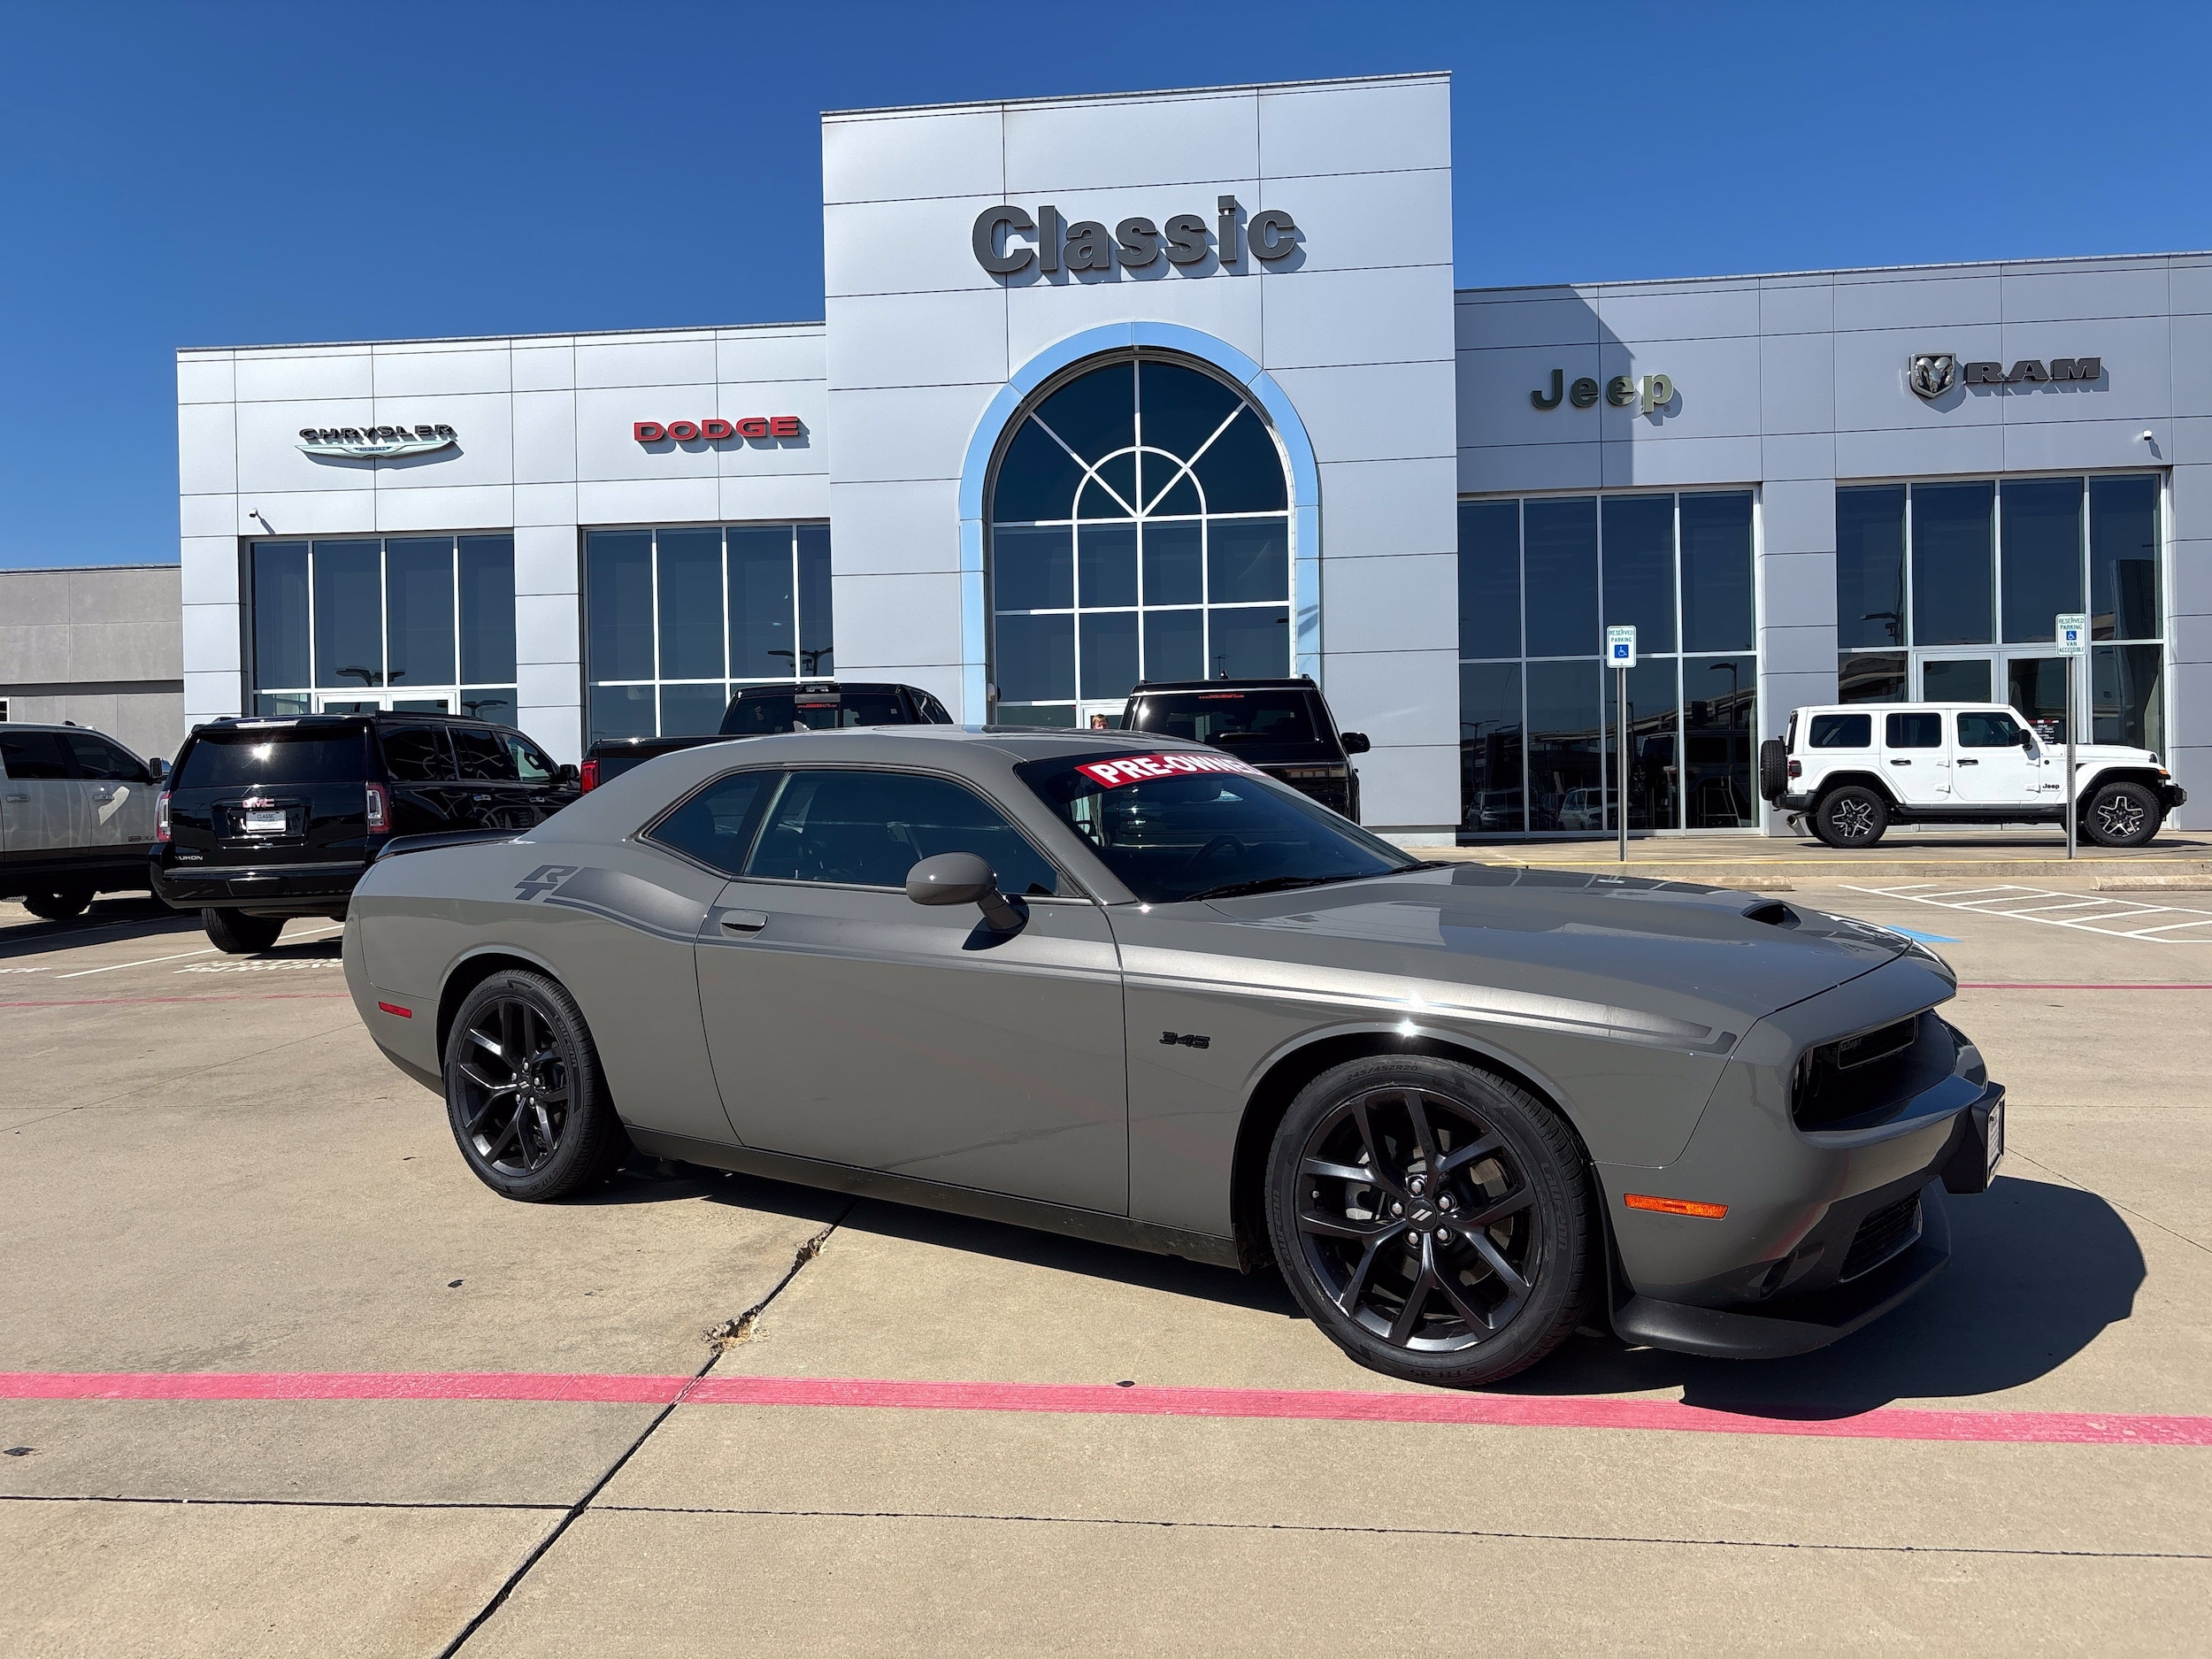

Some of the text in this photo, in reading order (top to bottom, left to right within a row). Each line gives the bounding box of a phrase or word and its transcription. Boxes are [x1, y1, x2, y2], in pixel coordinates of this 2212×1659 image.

[972, 195, 1295, 272] Classic
[1964, 357, 2102, 383] RAM
[1531, 368, 1674, 413] Jeep
[299, 424, 453, 440] CHRYSLER
[634, 416, 799, 442] DODGE
